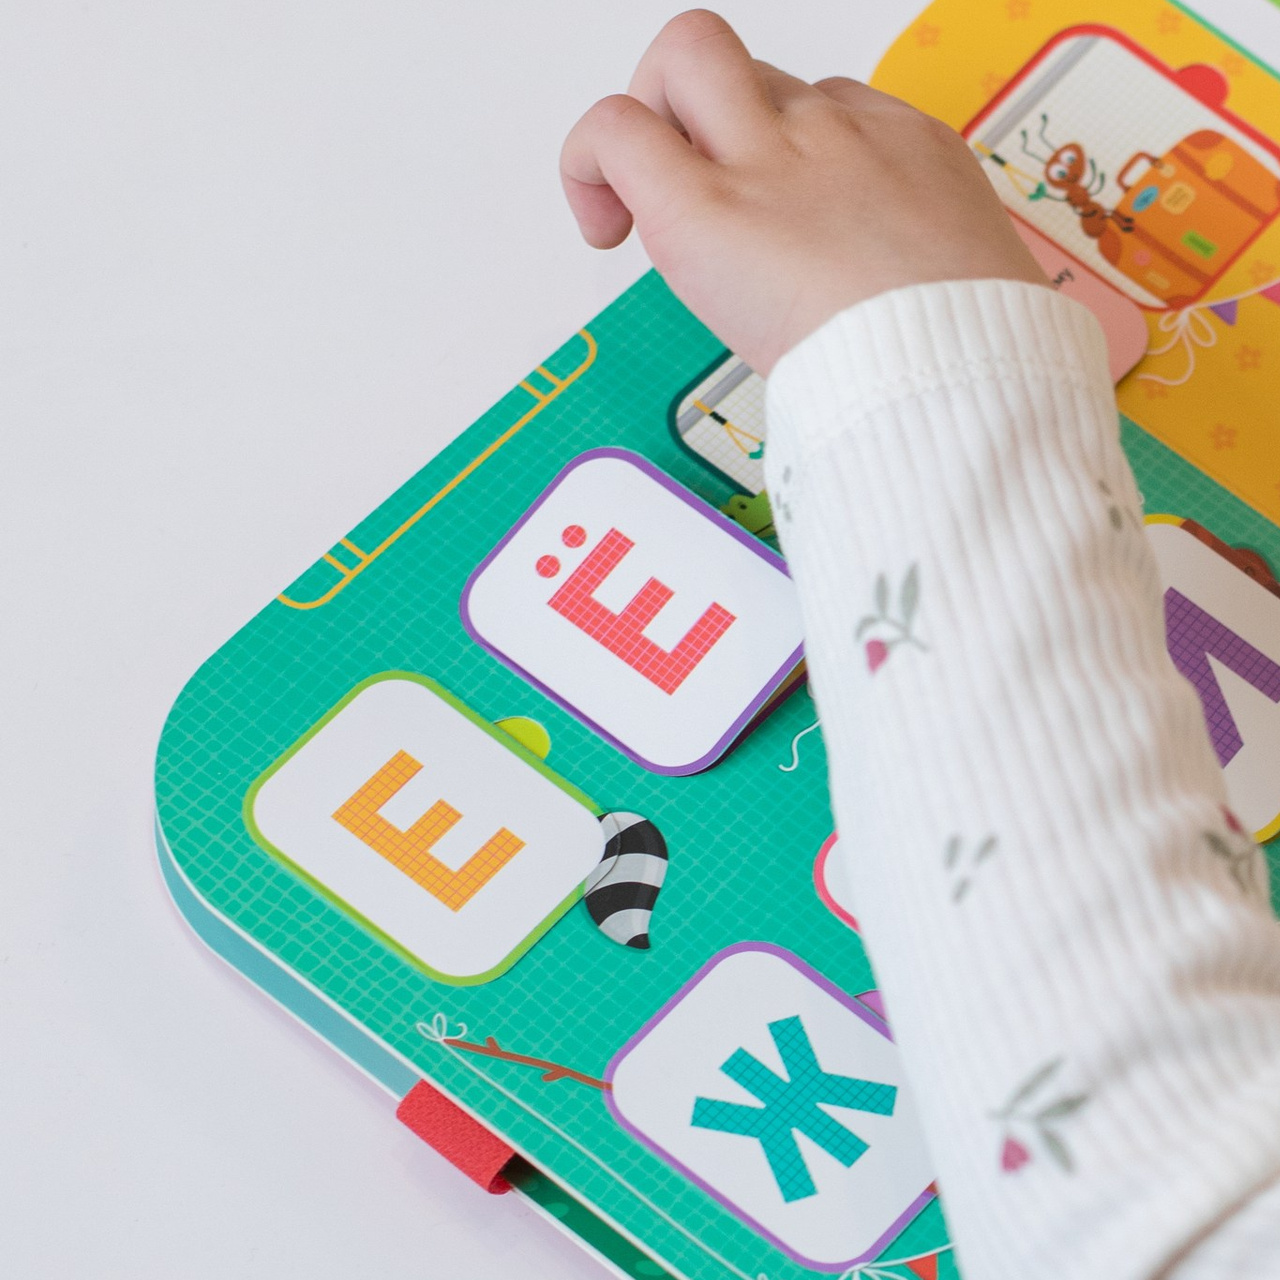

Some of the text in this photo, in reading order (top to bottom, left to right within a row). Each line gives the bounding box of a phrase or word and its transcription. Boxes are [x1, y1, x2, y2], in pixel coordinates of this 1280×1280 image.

[535, 524, 737, 696] Ё
[330, 750, 526, 912] Е
[690, 1015, 897, 1204] Ж
